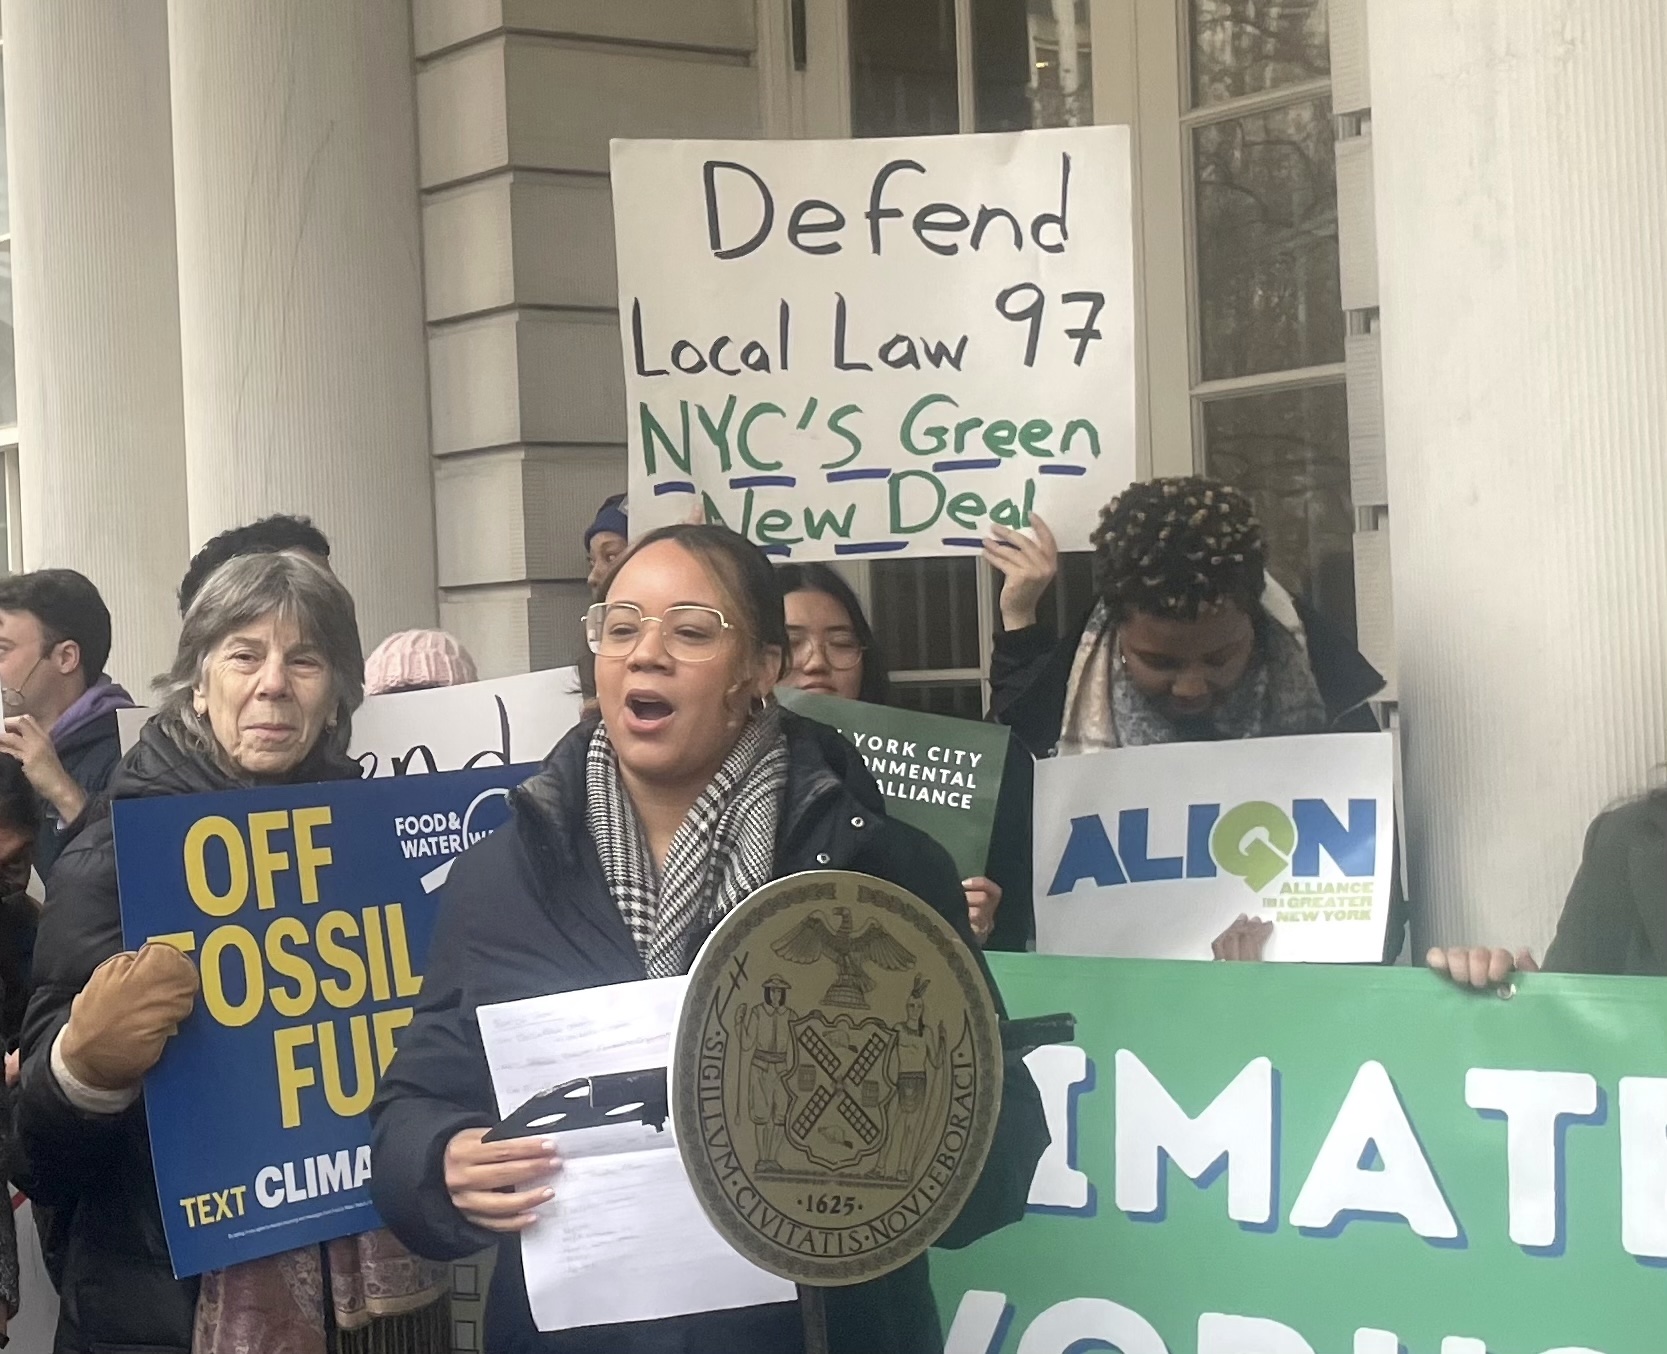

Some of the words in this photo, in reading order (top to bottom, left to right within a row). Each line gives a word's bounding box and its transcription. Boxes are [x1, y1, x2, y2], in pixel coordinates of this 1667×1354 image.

[703, 152, 1071, 260] Defend
[633, 297, 789, 376] Local
[834, 291, 969, 372] Law
[995, 282, 1105, 367] 97
[639, 394, 863, 476] NYC'S
[900, 393, 1101, 459] Green
[701, 488, 856, 544] New
[889, 469, 1036, 535] Deal
[853, 732, 917, 758] YORK
[927, 746, 982, 768] CITY
[184, 805, 333, 917] OFF
[400, 833, 463, 859] WATER
[1046, 798, 1376, 896] ALIGN
[1276, 911, 1319, 922] NEW
[1323, 910, 1371, 921] YORK
[1280, 882, 1374, 894] ALLIANCE
[1287, 896, 1373, 909] GREATER
[147, 903, 424, 1036] OSSIL
[180, 1185, 246, 1228] TEXT
[255, 1145, 372, 1208] CLIMA
[736, 1186, 863, 1254] CIVITATIS
[867, 1186, 934, 1245] NOVI
[929, 1062, 974, 1189] EBORACI
[806, 1194, 856, 1216] 1625
